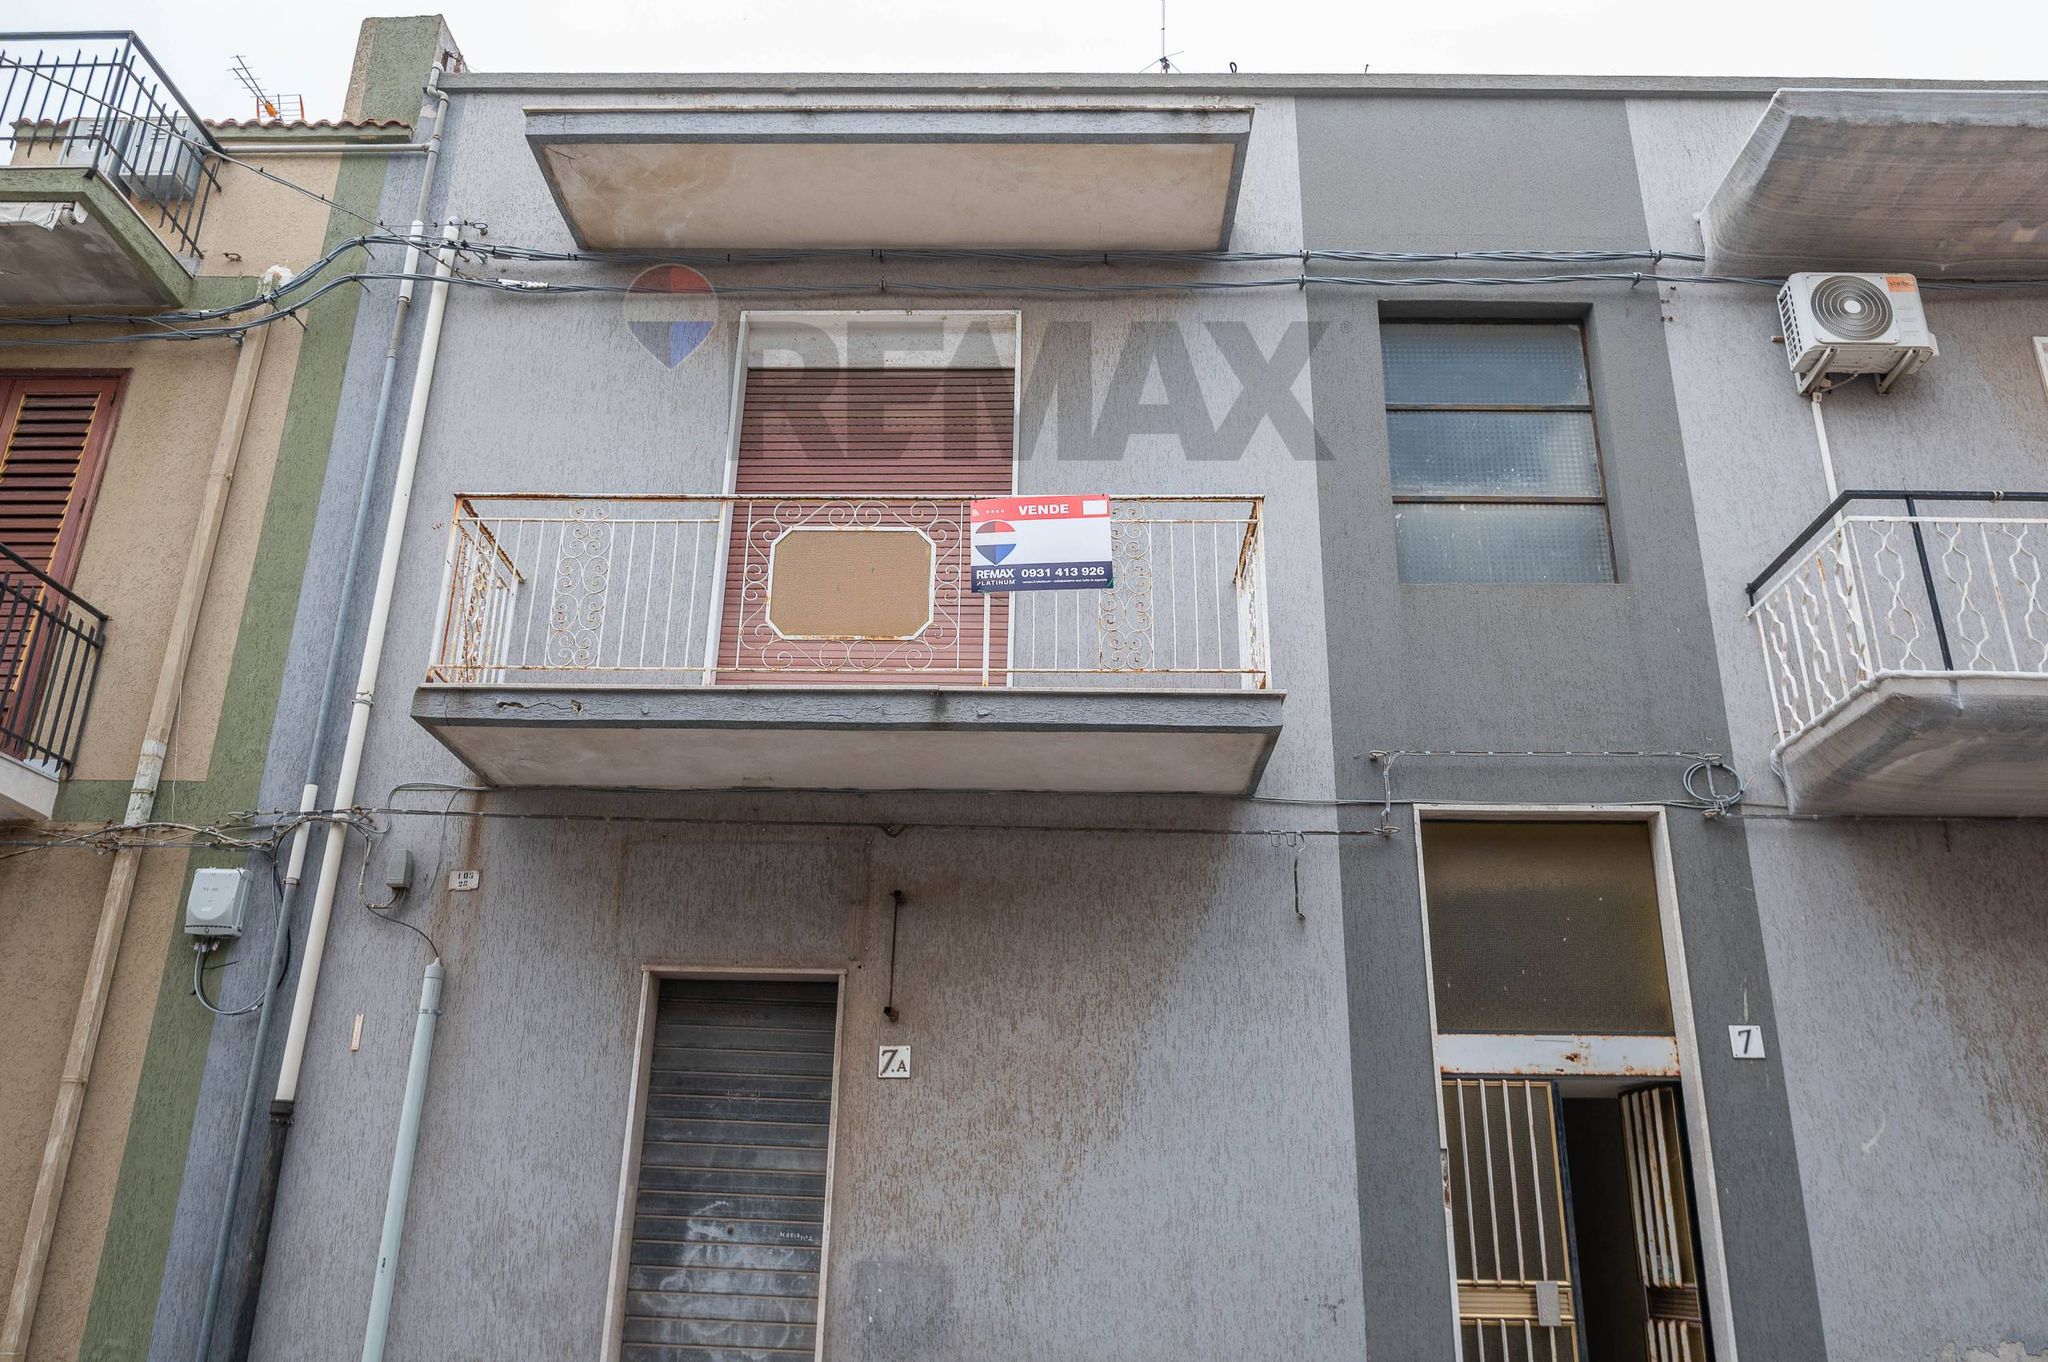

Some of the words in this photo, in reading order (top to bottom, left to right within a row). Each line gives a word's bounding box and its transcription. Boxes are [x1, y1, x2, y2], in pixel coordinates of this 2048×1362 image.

[1018, 504, 1070, 516] VENDE
[976, 569, 1015, 579] REMAX
[1021, 568, 1051, 578] 0931
[1055, 567, 1079, 577] 413
[1081, 566, 1105, 576] 926
[1738, 1029, 1752, 1054] 7
